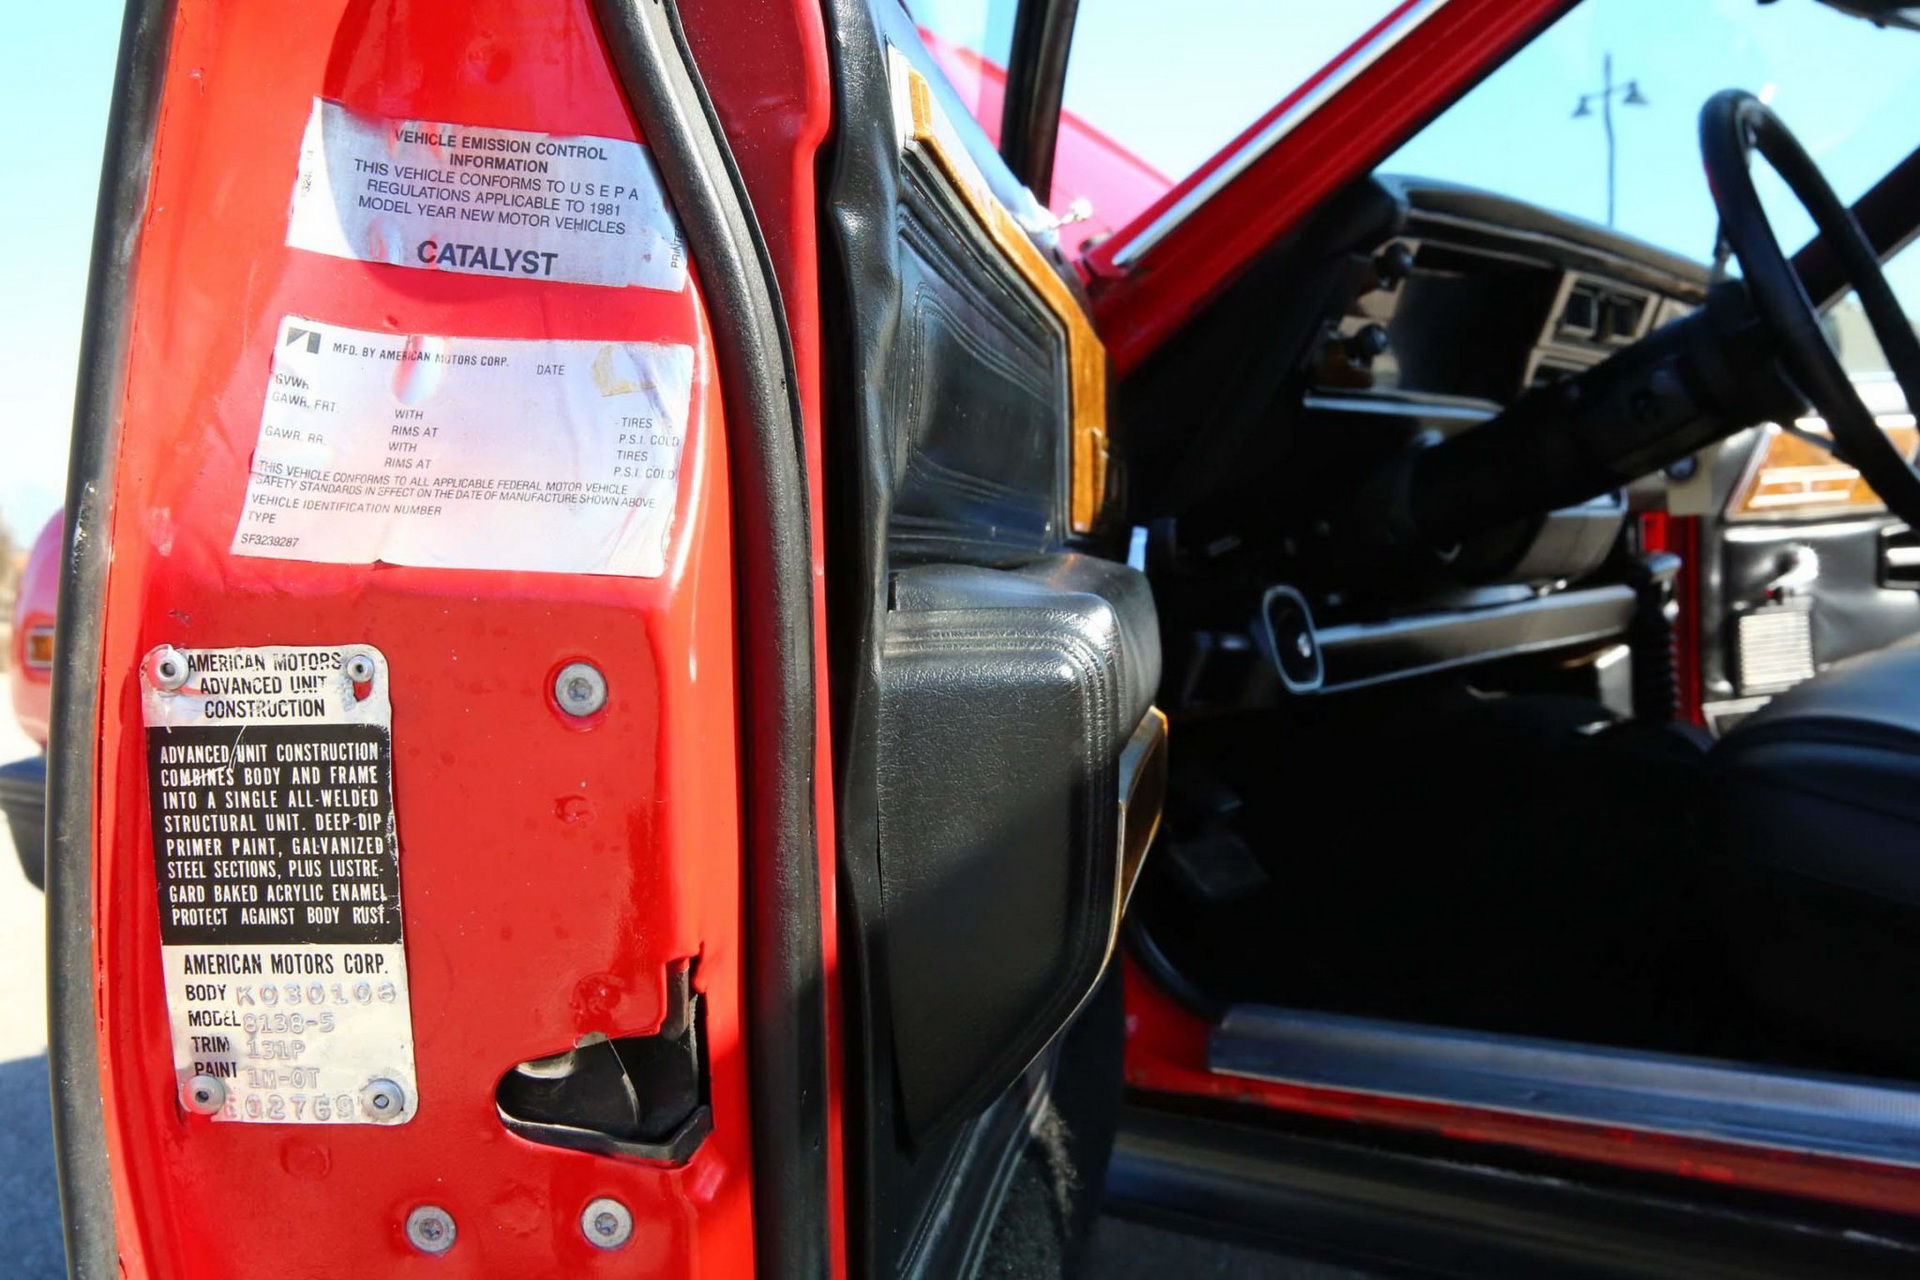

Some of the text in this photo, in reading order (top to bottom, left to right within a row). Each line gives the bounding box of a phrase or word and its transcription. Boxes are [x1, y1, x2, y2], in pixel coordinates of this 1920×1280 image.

[395, 130, 607, 160] VEHICLE EMISSION CONTROL
[450, 154, 548, 173] INFORMATION
[354, 158, 388, 175] THIS
[394, 165, 455, 183] VEHICLE
[460, 173, 541, 191] CONFORMS
[546, 180, 565, 193] TO
[367, 179, 620, 216] REGULATIONS APPLICABLE TO 1981
[358, 195, 626, 234] MODEL YEAR NEW MOTOR VEHICLES
[417, 240, 559, 275] CATALYST
[333, 342, 509, 367] MFD. BY AMERICAN MOTORS CORP.
[536, 364, 566, 376] DATE
[395, 409, 424, 420] WITH
[621, 417, 653, 429] TIRES
[392, 425, 439, 438] RIMS AT
[650, 435, 679, 447] COLD
[388, 441, 417, 453] WITH
[616, 450, 648, 462] TIRES
[384, 457, 432, 469] RIMS AT
[259, 459, 628, 495] THIS VEHICLE CONFORMS TO ALL APPLICABLE FEDERAL MOTOR VEHICLE
[645, 468, 675, 480] COLD
[255, 474, 656, 509] SAFETY STANDARDS IN EFFECT ON THE DATE OF MANUFACTURE SHOWN ABOVE
[252, 493, 442, 516] VEHICLE IDENTIFICATION NUMBER
[248, 511, 276, 524] TYPE
[241, 533, 299, 548] SF3239287
[187, 652, 343, 672] AMERICAN MOTORS
[200, 675, 327, 695] ADVANCED UNIT
[205, 699, 325, 718] CONSTRUCTION
[160, 742, 379, 764] ADVANCED UNIT CONSTRUCTION
[161, 765, 378, 787] COMBINES BODY AND FRAME
[163, 789, 379, 810] INTO A SINGLE ALL-WELDED
[164, 812, 382, 833] STRUCTURAL UNIT. DEEP-DIP
[166, 836, 384, 858] PRIMER PAINT, GALVANIZED
[167, 859, 384, 880] STEEL SECTIONS, PLUS LUSTRE-
[169, 883, 387, 904] GARD BAKED ACRYLIC ENAMEL
[172, 905, 390, 926] PROTECT AGAINST BODY RUST.
[184, 953, 389, 975] AMERICAN MOTORS CORP.
[185, 984, 226, 1001] BODY
[188, 1010, 241, 1027] MODEL
[192, 1036, 231, 1053] TRIM
[194, 1062, 237, 1078] PAINT
